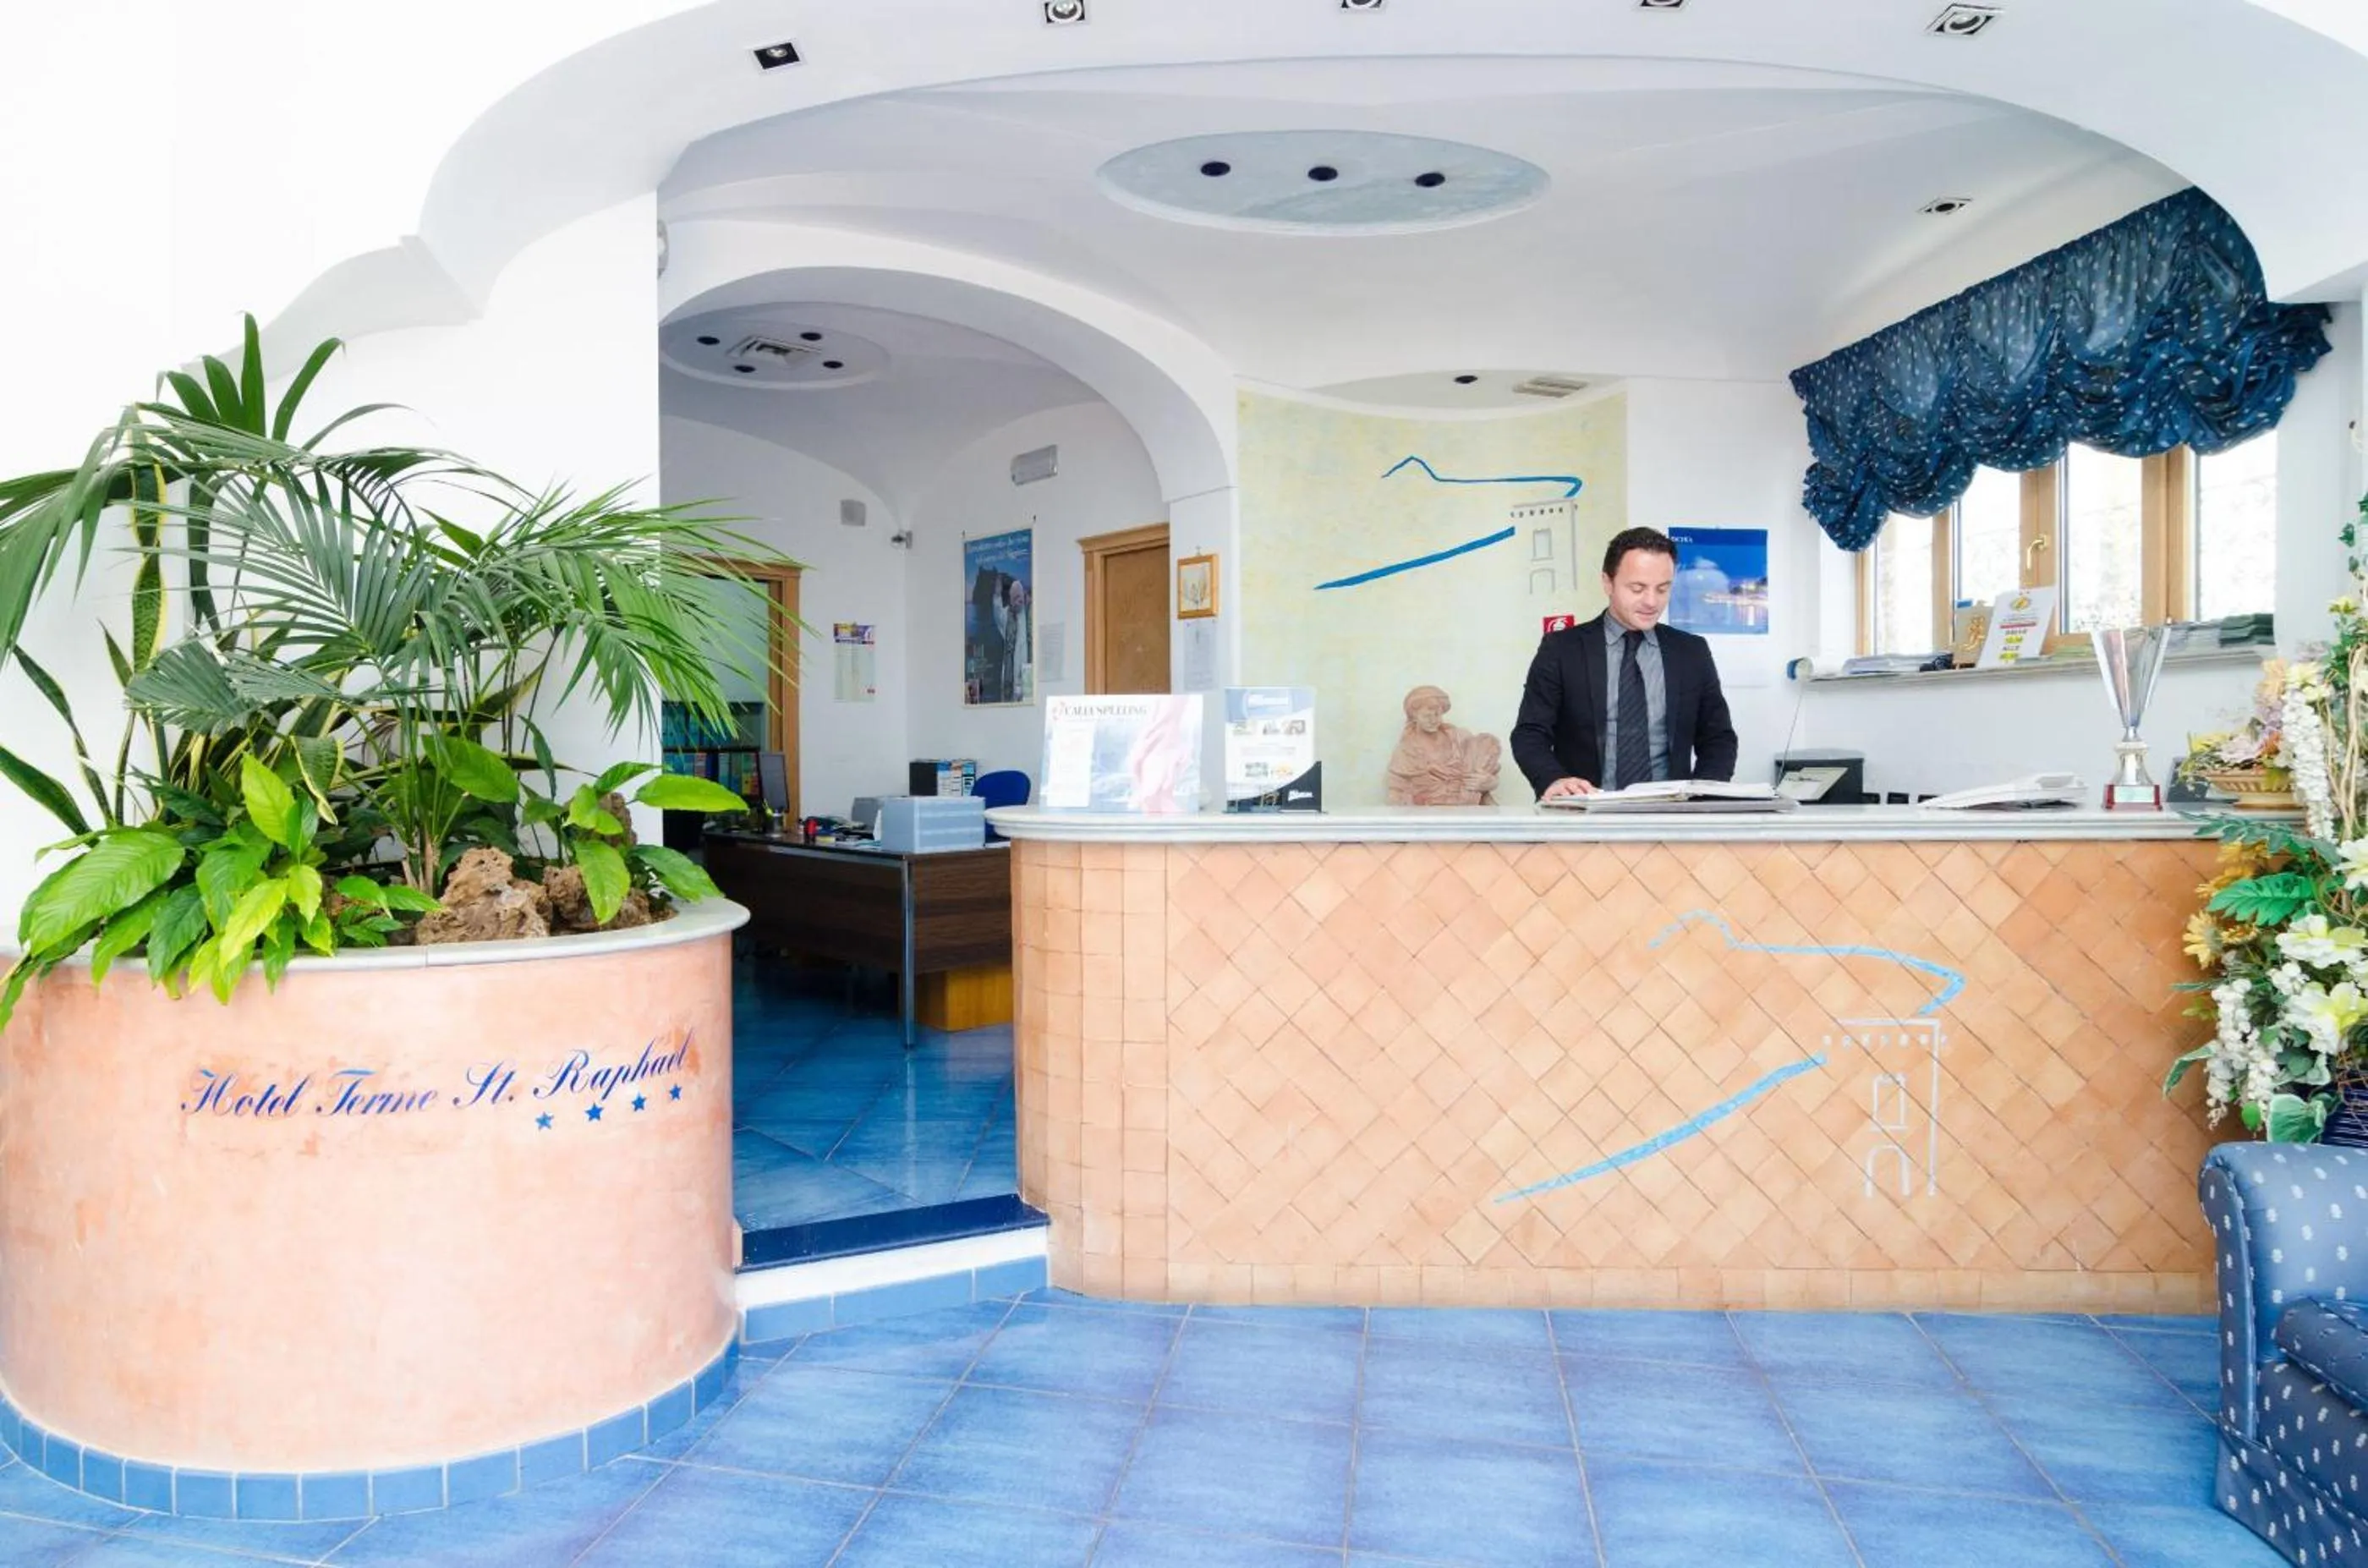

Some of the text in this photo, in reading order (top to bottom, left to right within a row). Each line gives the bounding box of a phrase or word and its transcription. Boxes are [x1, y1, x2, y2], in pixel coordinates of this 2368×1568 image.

[181, 1026, 694, 1117] Hotel Terme St. Raphael
